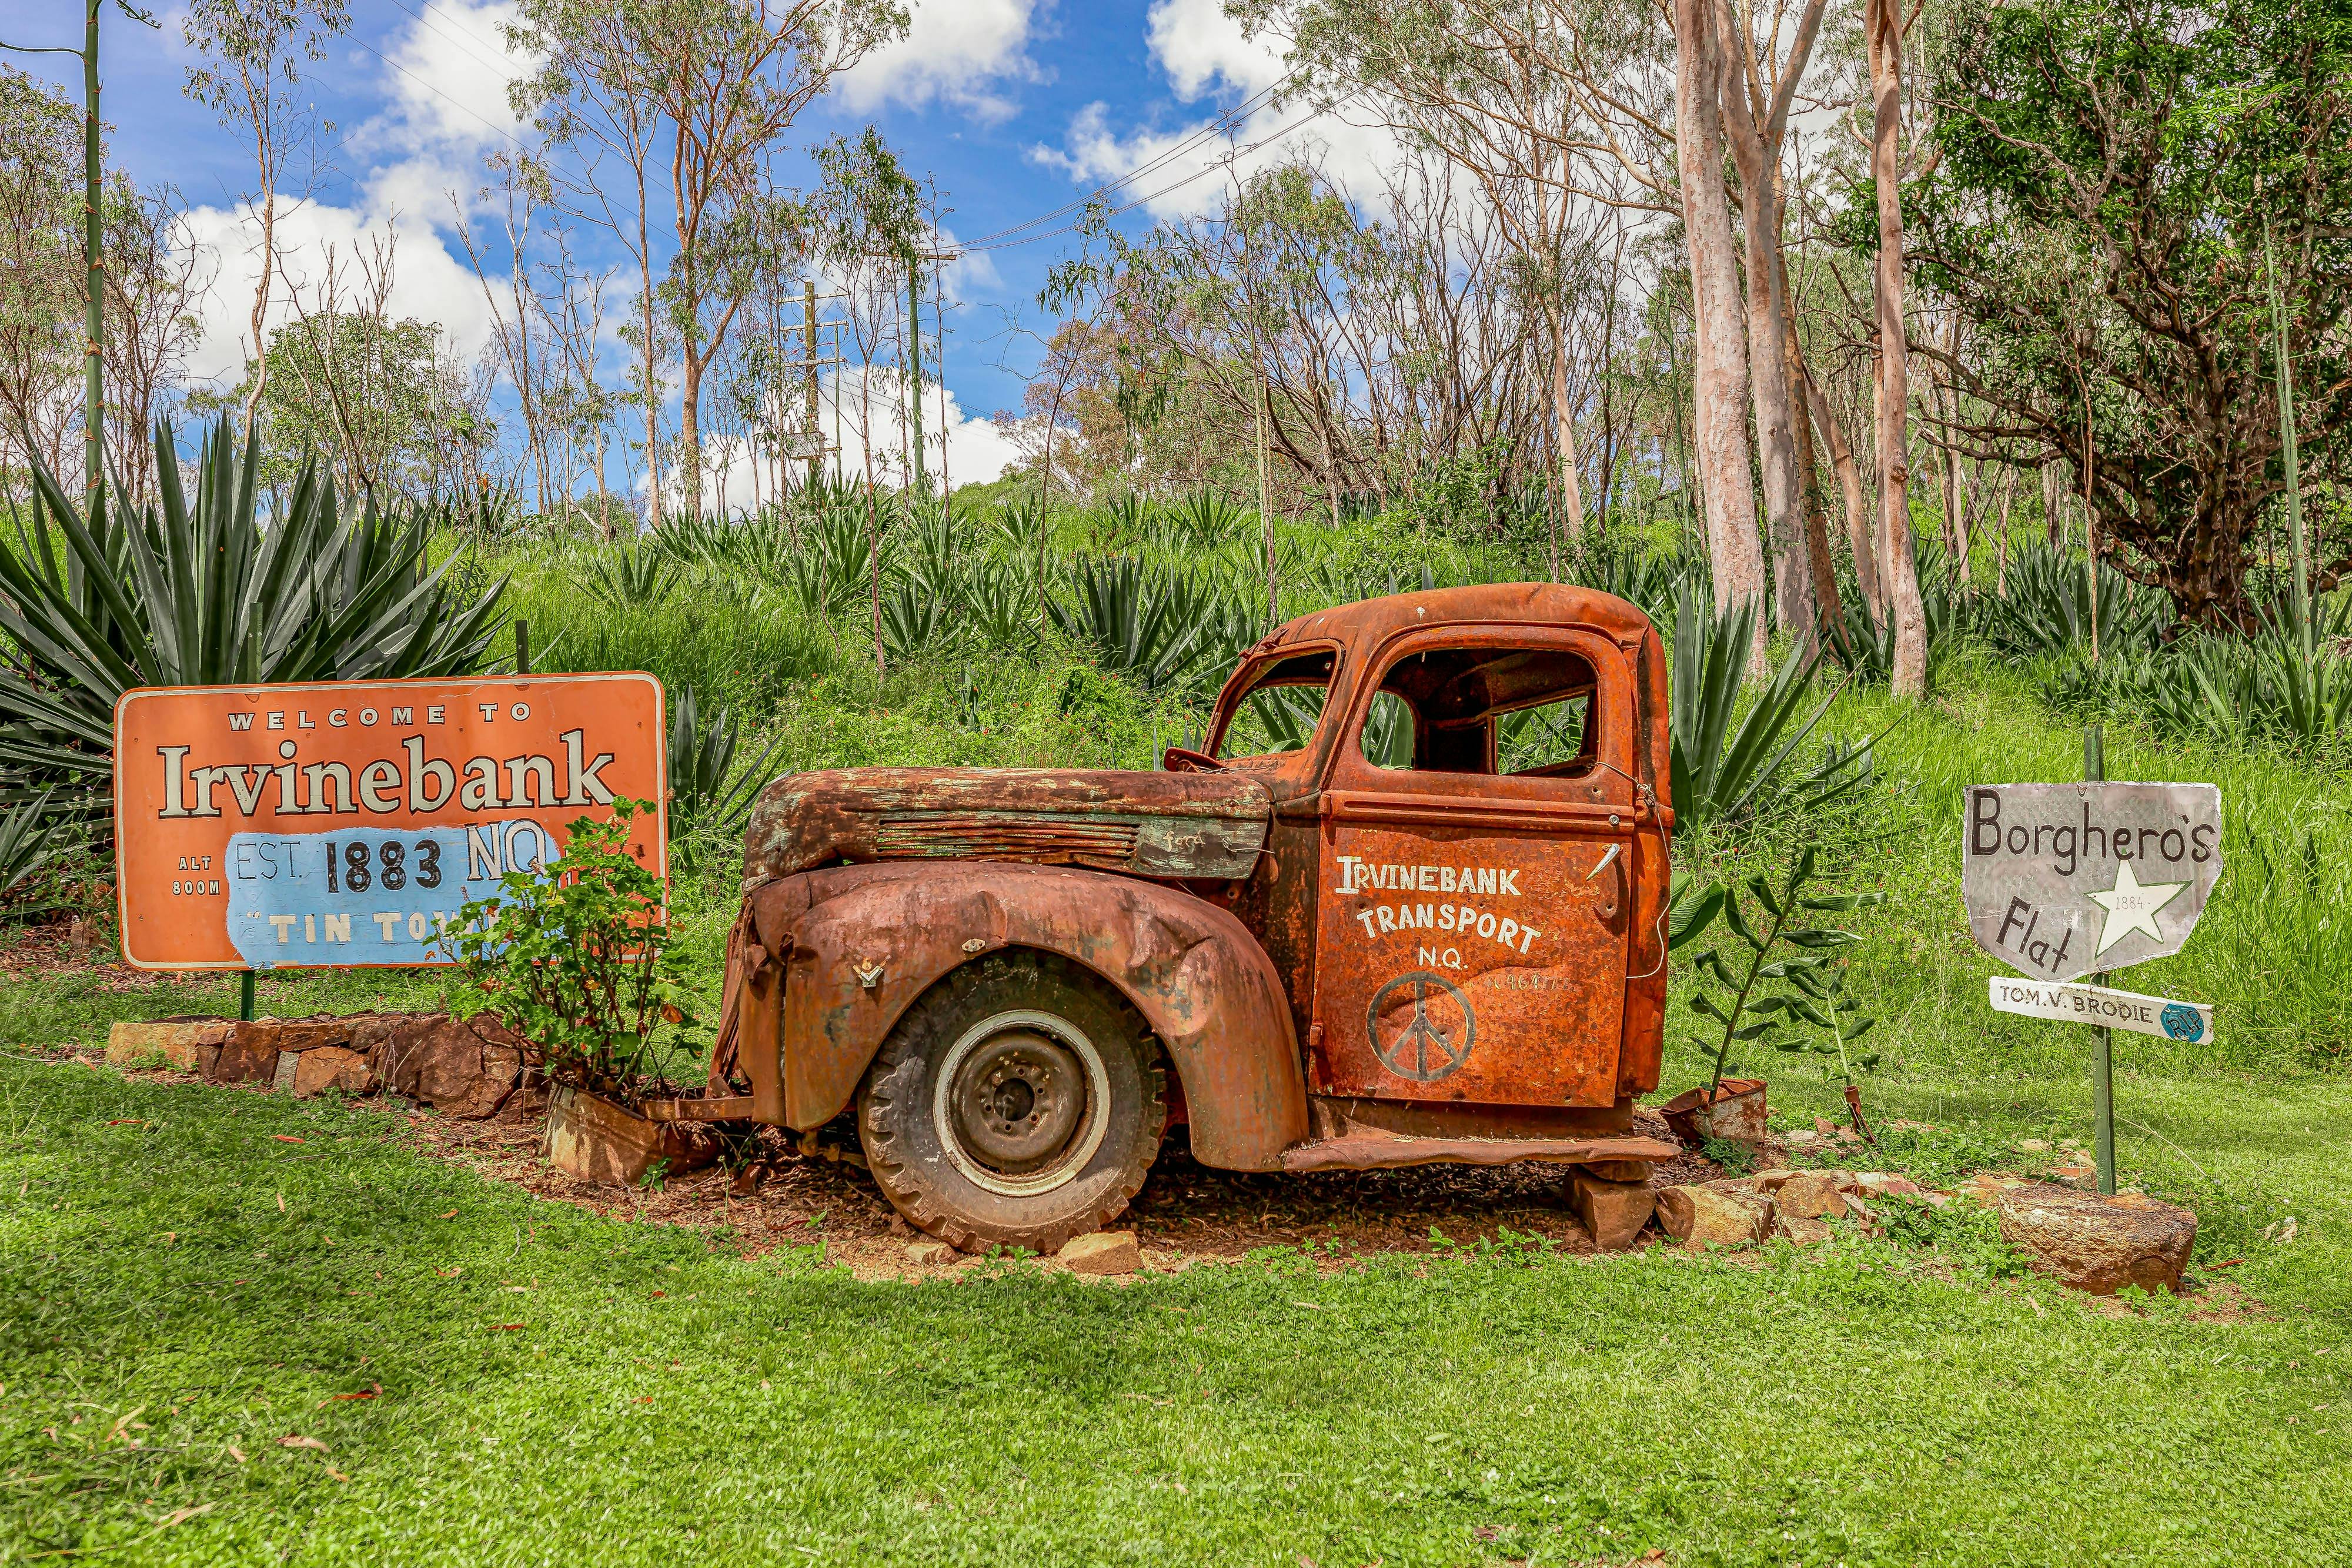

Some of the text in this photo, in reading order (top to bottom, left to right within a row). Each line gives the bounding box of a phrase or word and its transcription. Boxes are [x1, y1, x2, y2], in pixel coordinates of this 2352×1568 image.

[228, 703, 531, 731] WELCOME TO
[156, 728, 616, 818] Irvinebank
[464, 818, 548, 881] NQ
[1971, 788, 2216, 877] Borghero's
[178, 855, 211, 871] ALT
[236, 839, 441, 893] EST. 1883
[1335, 856, 1523, 897] IRVINEBANK
[172, 880, 220, 895] 800M
[2116, 896, 2146, 910] 1884
[1357, 903, 1542, 955] TRANSPORT
[1996, 895, 2073, 974] Flat
[1418, 946, 1469, 970] N.Q.
[2073, 996, 2154, 1024] BRODIE
[2166, 1009, 2205, 1039] RIP
